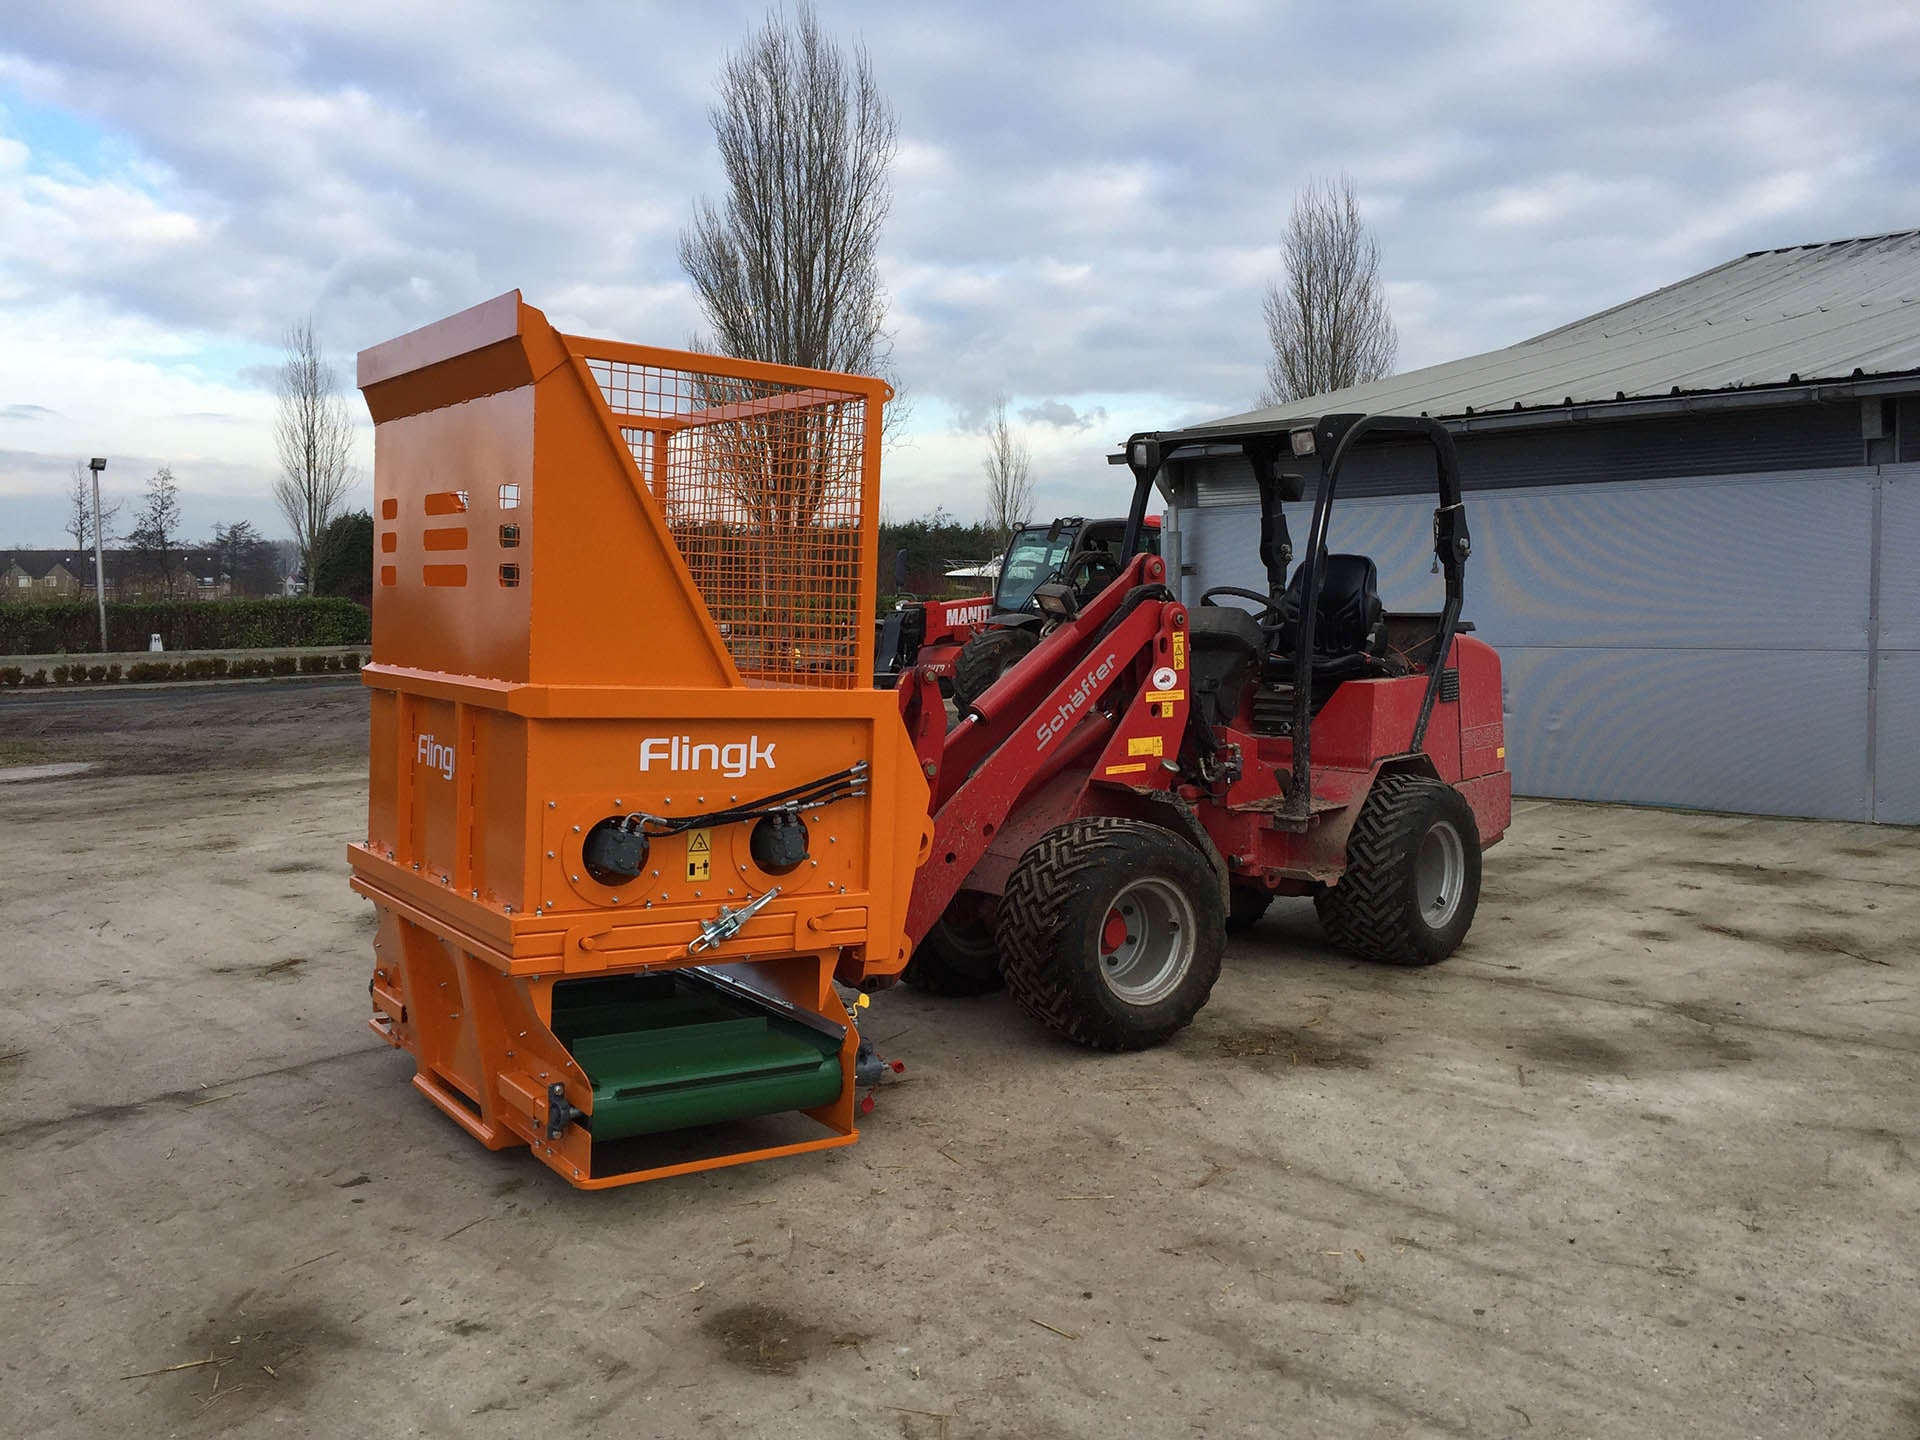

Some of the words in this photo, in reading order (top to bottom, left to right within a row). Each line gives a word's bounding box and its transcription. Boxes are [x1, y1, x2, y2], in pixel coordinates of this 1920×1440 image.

[946, 604, 992, 626] MANIT
[1036, 653, 1115, 751] Schäffer
[418, 734, 455, 780] Fling
[640, 735, 776, 777] Flingk
